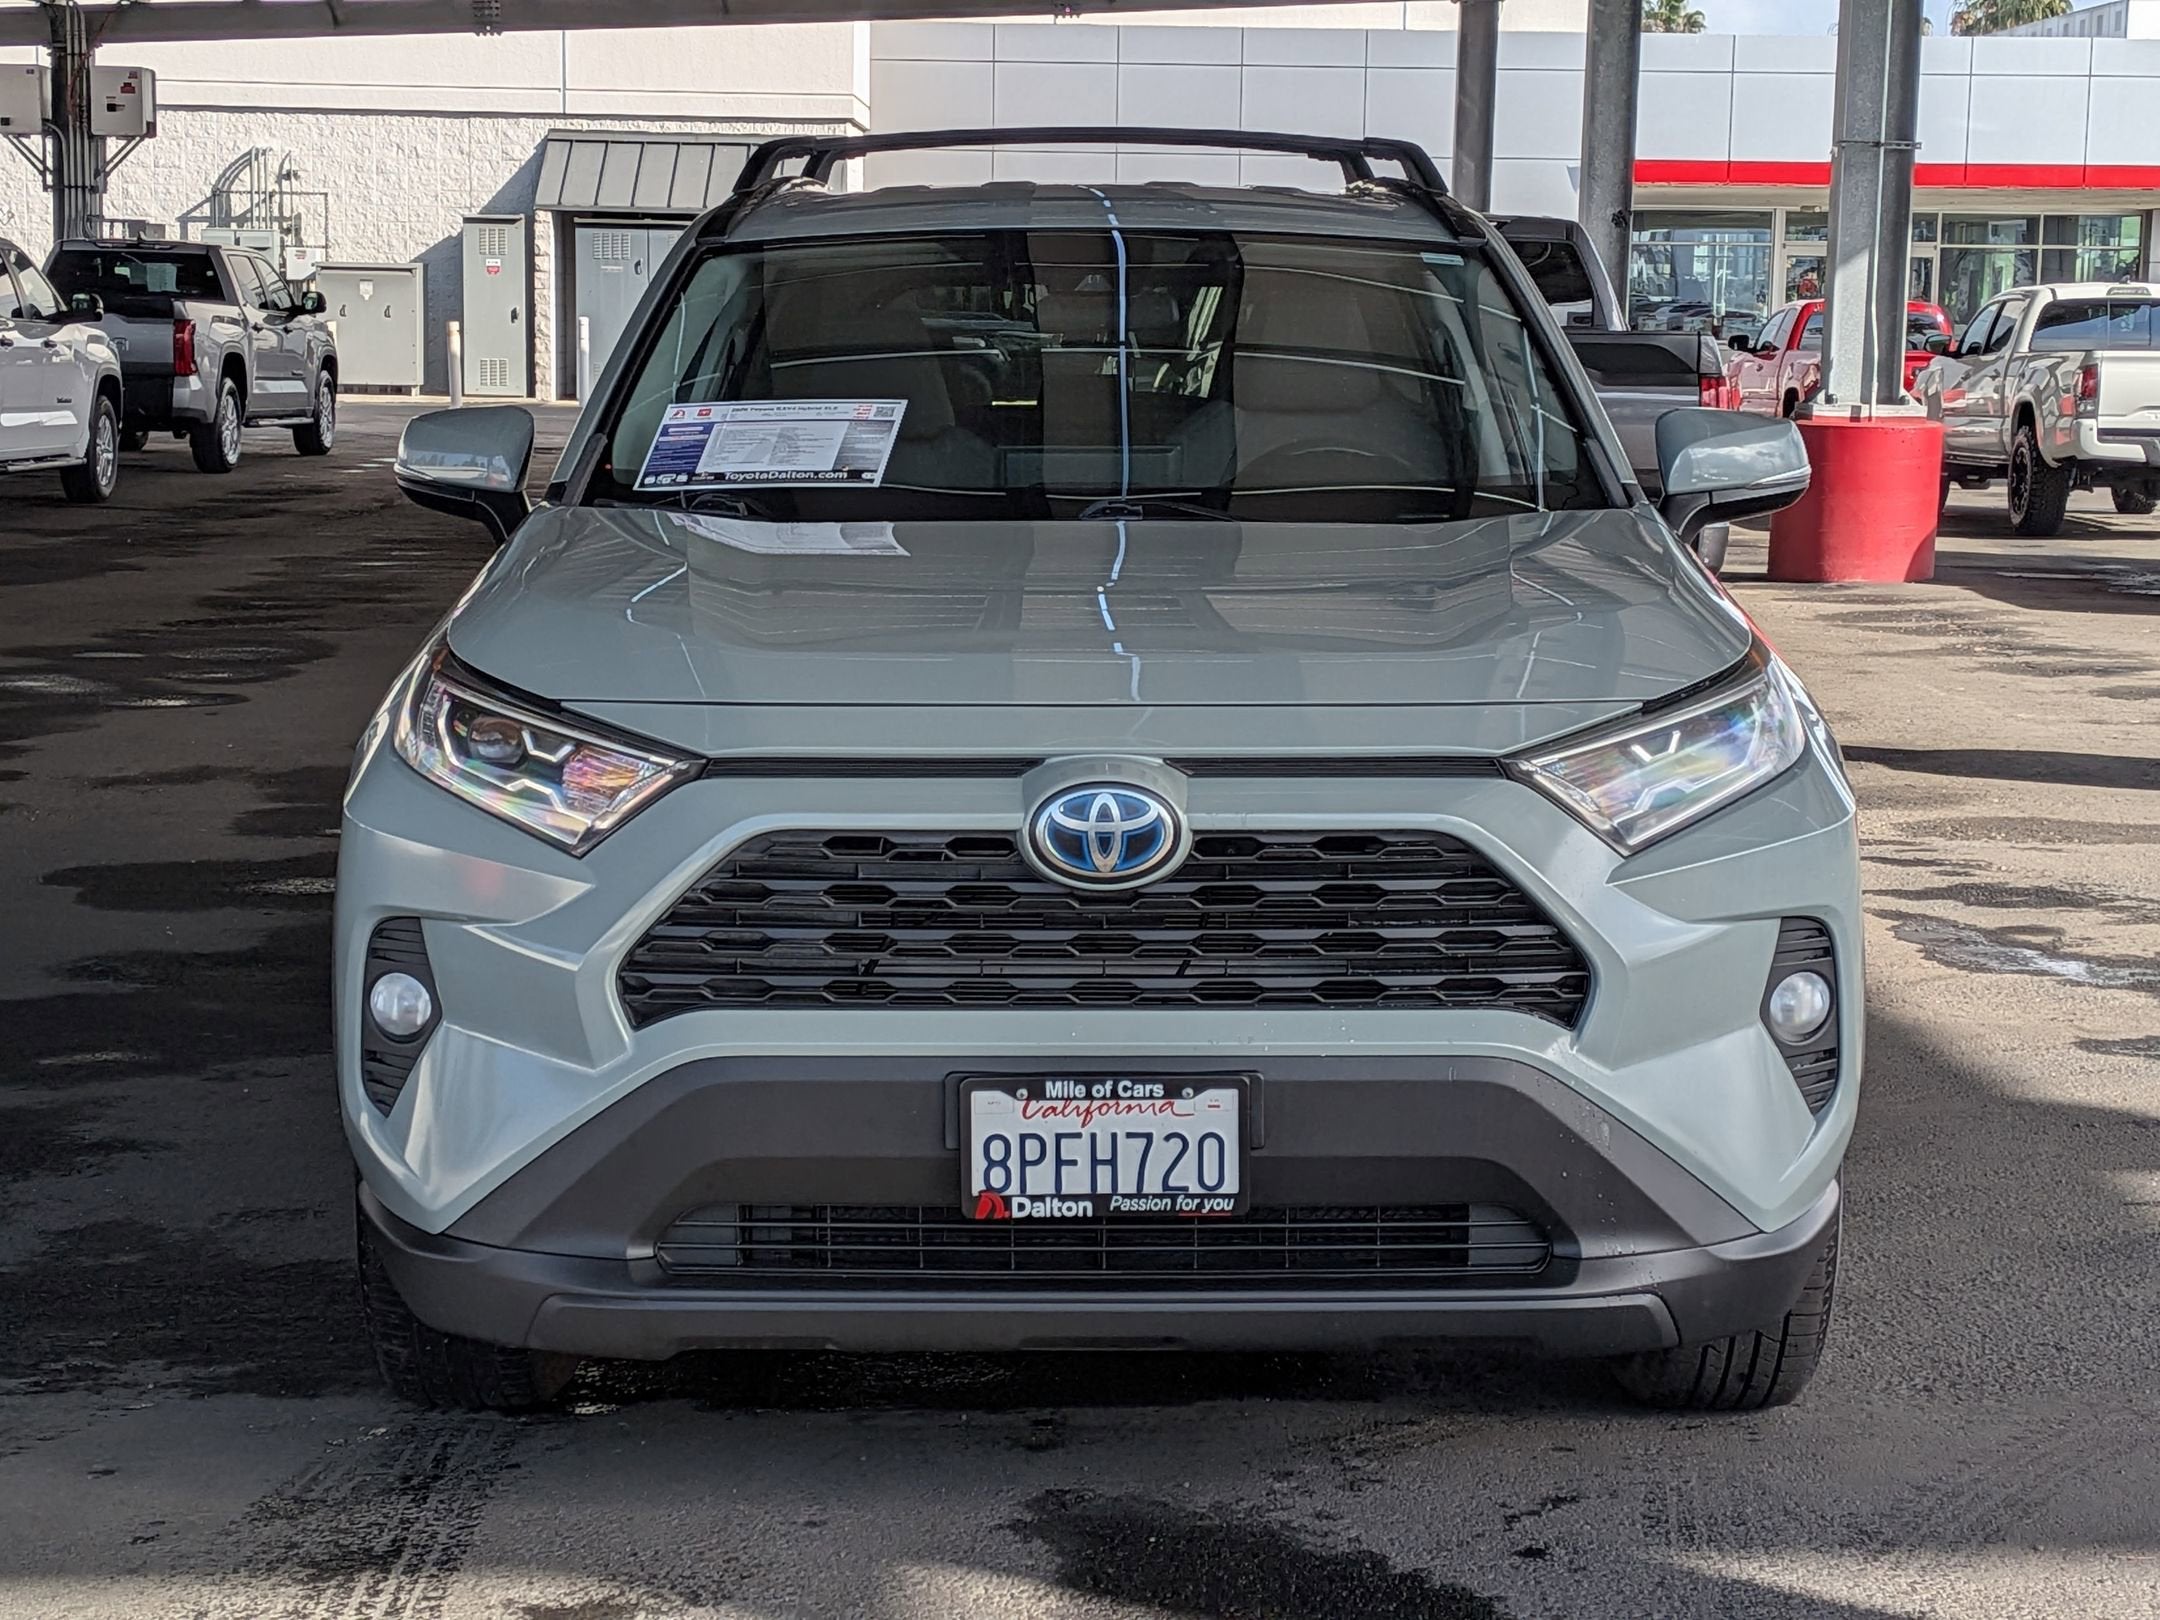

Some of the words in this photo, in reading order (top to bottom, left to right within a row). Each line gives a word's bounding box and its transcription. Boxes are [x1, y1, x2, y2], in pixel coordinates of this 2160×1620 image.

[724, 470, 848, 481] ToyotaDalton.com
[1045, 1080, 1086, 1098] Mile
[1091, 1080, 1113, 1098] of
[1117, 1080, 1165, 1098] Cars
[1021, 1099, 1195, 1128] California
[983, 1131, 1226, 1195] 8PFH720
[1011, 1197, 1093, 1218] Dalton
[1109, 1195, 1171, 1212] Passion
[1175, 1195, 1199, 1212] for
[1201, 1198, 1235, 1214] you
